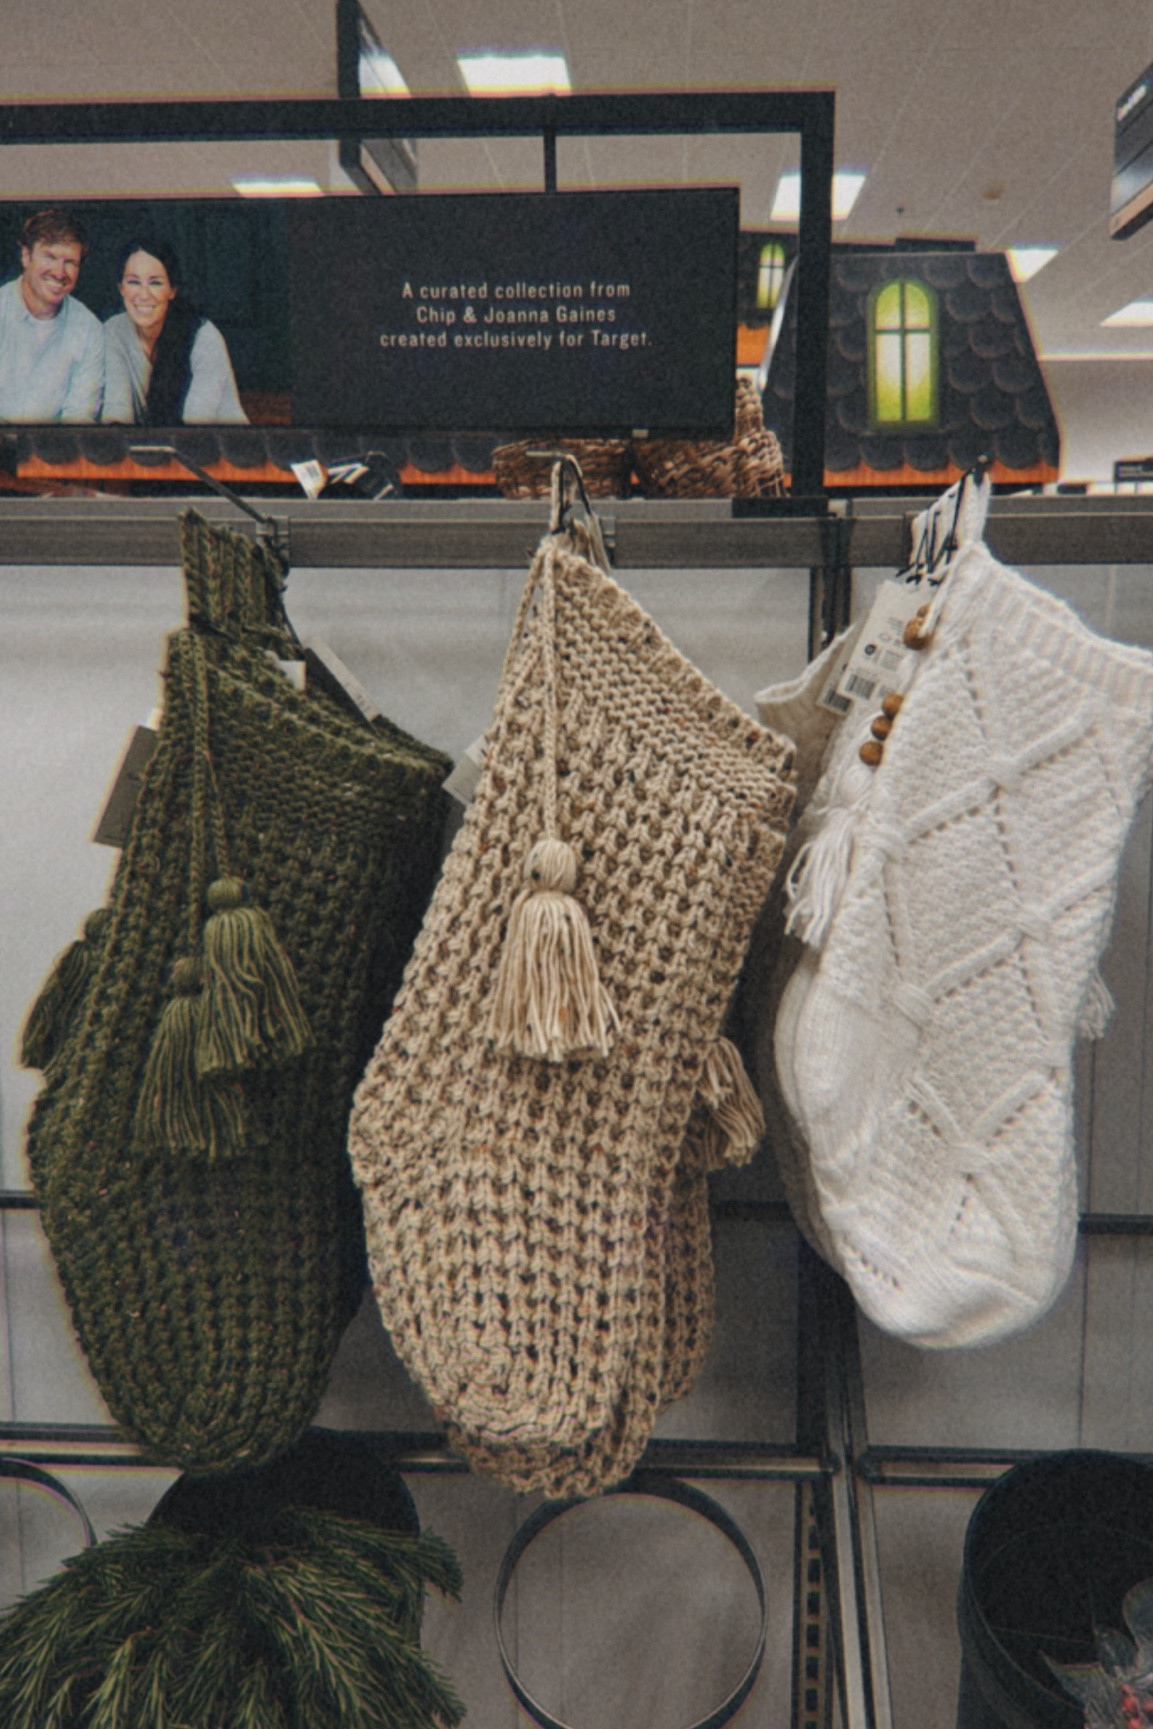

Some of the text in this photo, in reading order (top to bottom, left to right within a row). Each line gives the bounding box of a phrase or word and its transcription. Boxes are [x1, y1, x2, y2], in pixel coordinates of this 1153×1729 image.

[402, 281, 631, 299] A curated collection from
[416, 305, 616, 326] Chip & Joanna Gaines
[379, 330, 653, 349] created exclusively for Target.
